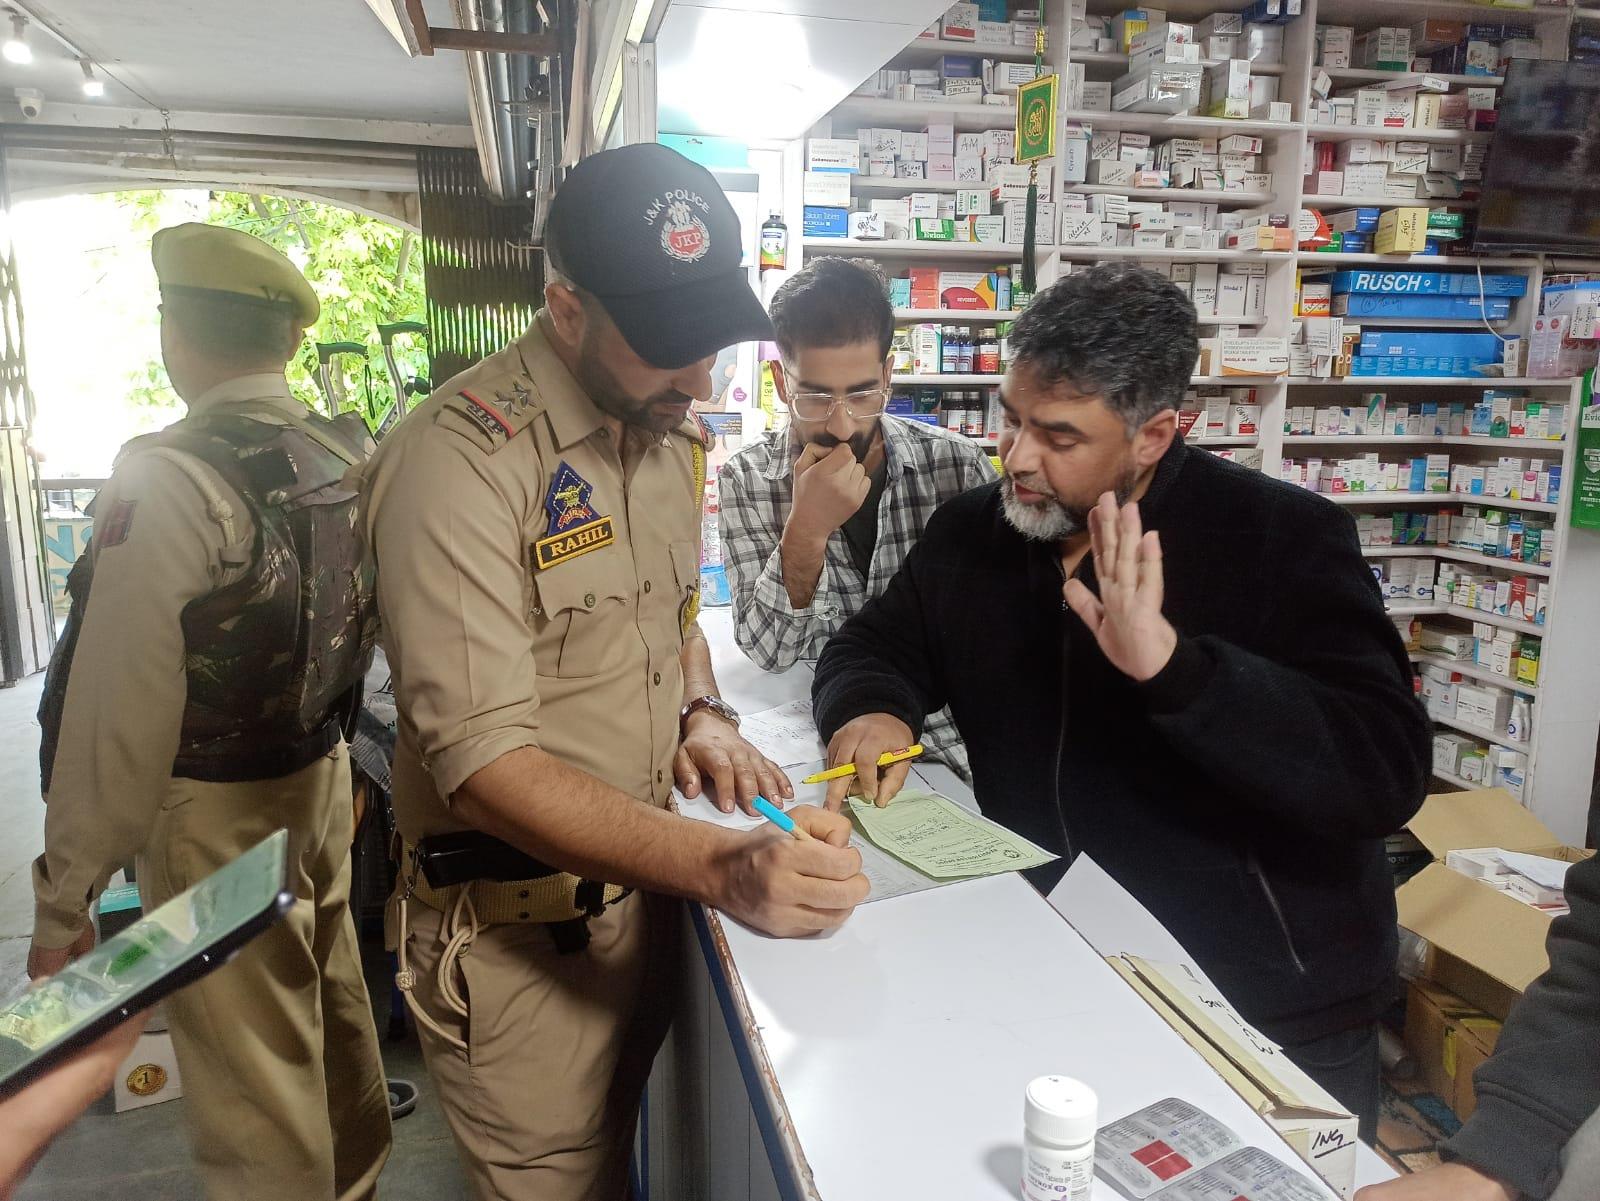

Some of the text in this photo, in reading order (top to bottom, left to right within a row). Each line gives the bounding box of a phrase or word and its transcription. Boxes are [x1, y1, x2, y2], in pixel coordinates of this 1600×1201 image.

[641, 189, 710, 226] J&K POLICE
[674, 231, 703, 249] JKP
[1355, 273, 1421, 292] RÜSCH
[549, 526, 609, 557] RAHIL
